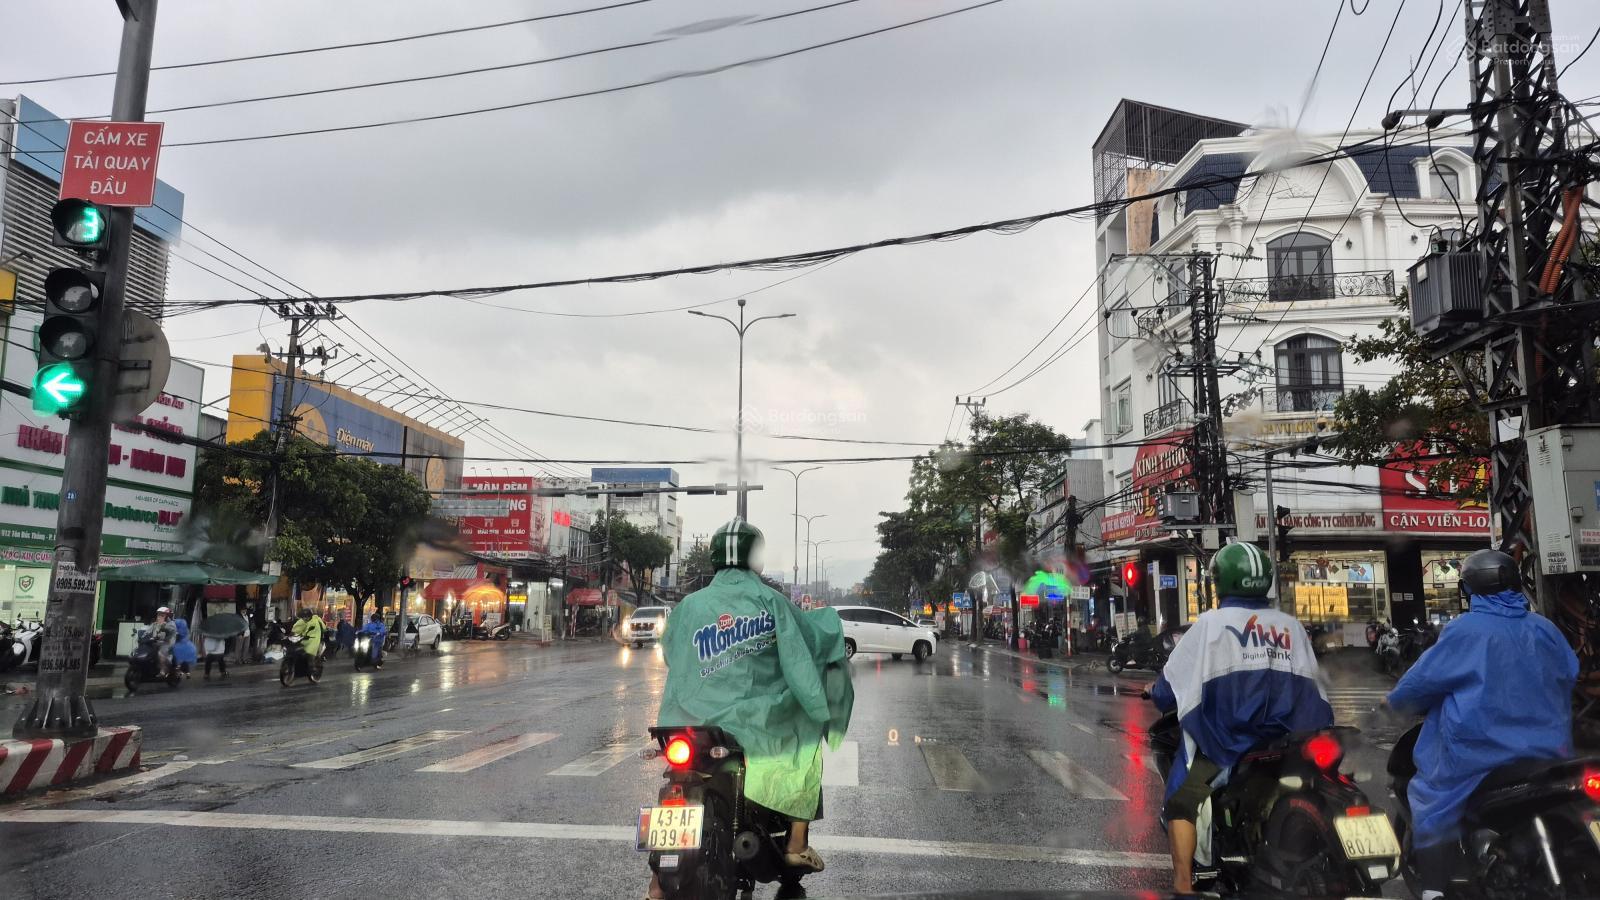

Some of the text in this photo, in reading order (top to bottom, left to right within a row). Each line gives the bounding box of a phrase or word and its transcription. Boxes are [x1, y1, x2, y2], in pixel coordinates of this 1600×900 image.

[84, 125, 148, 147] CẤM XE
[74, 151, 151, 171] TẢI QUAY
[90, 175, 127, 195] ĐẦU
[82, 206, 99, 242] 3
[336, 427, 356, 449] Điện
[1136, 452, 1158, 478] KÍNH
[1322, 515, 1332, 528] TY
[693, 610, 776, 661] Montinis
[1225, 613, 1291, 650] Vikki
[1242, 647, 1291, 661] Digital Bank
[657, 808, 696, 827] 43-AF
[650, 828, 697, 847] 039.41
